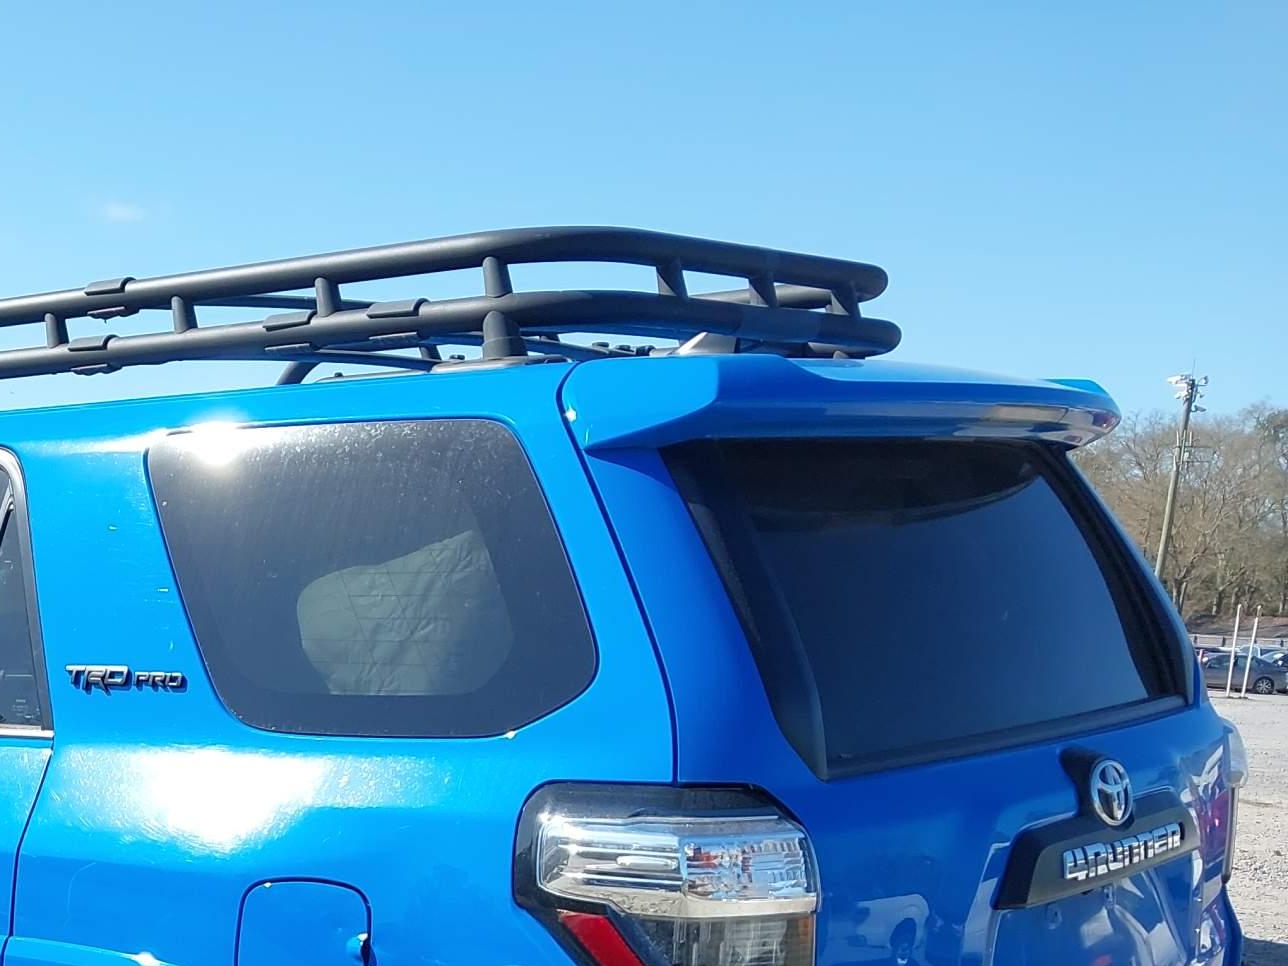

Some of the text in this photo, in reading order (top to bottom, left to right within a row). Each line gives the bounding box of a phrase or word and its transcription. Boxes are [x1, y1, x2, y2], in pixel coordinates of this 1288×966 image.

[65, 664, 183, 695] TRD PRO
[1063, 823, 1182, 881] 4RUNNER
